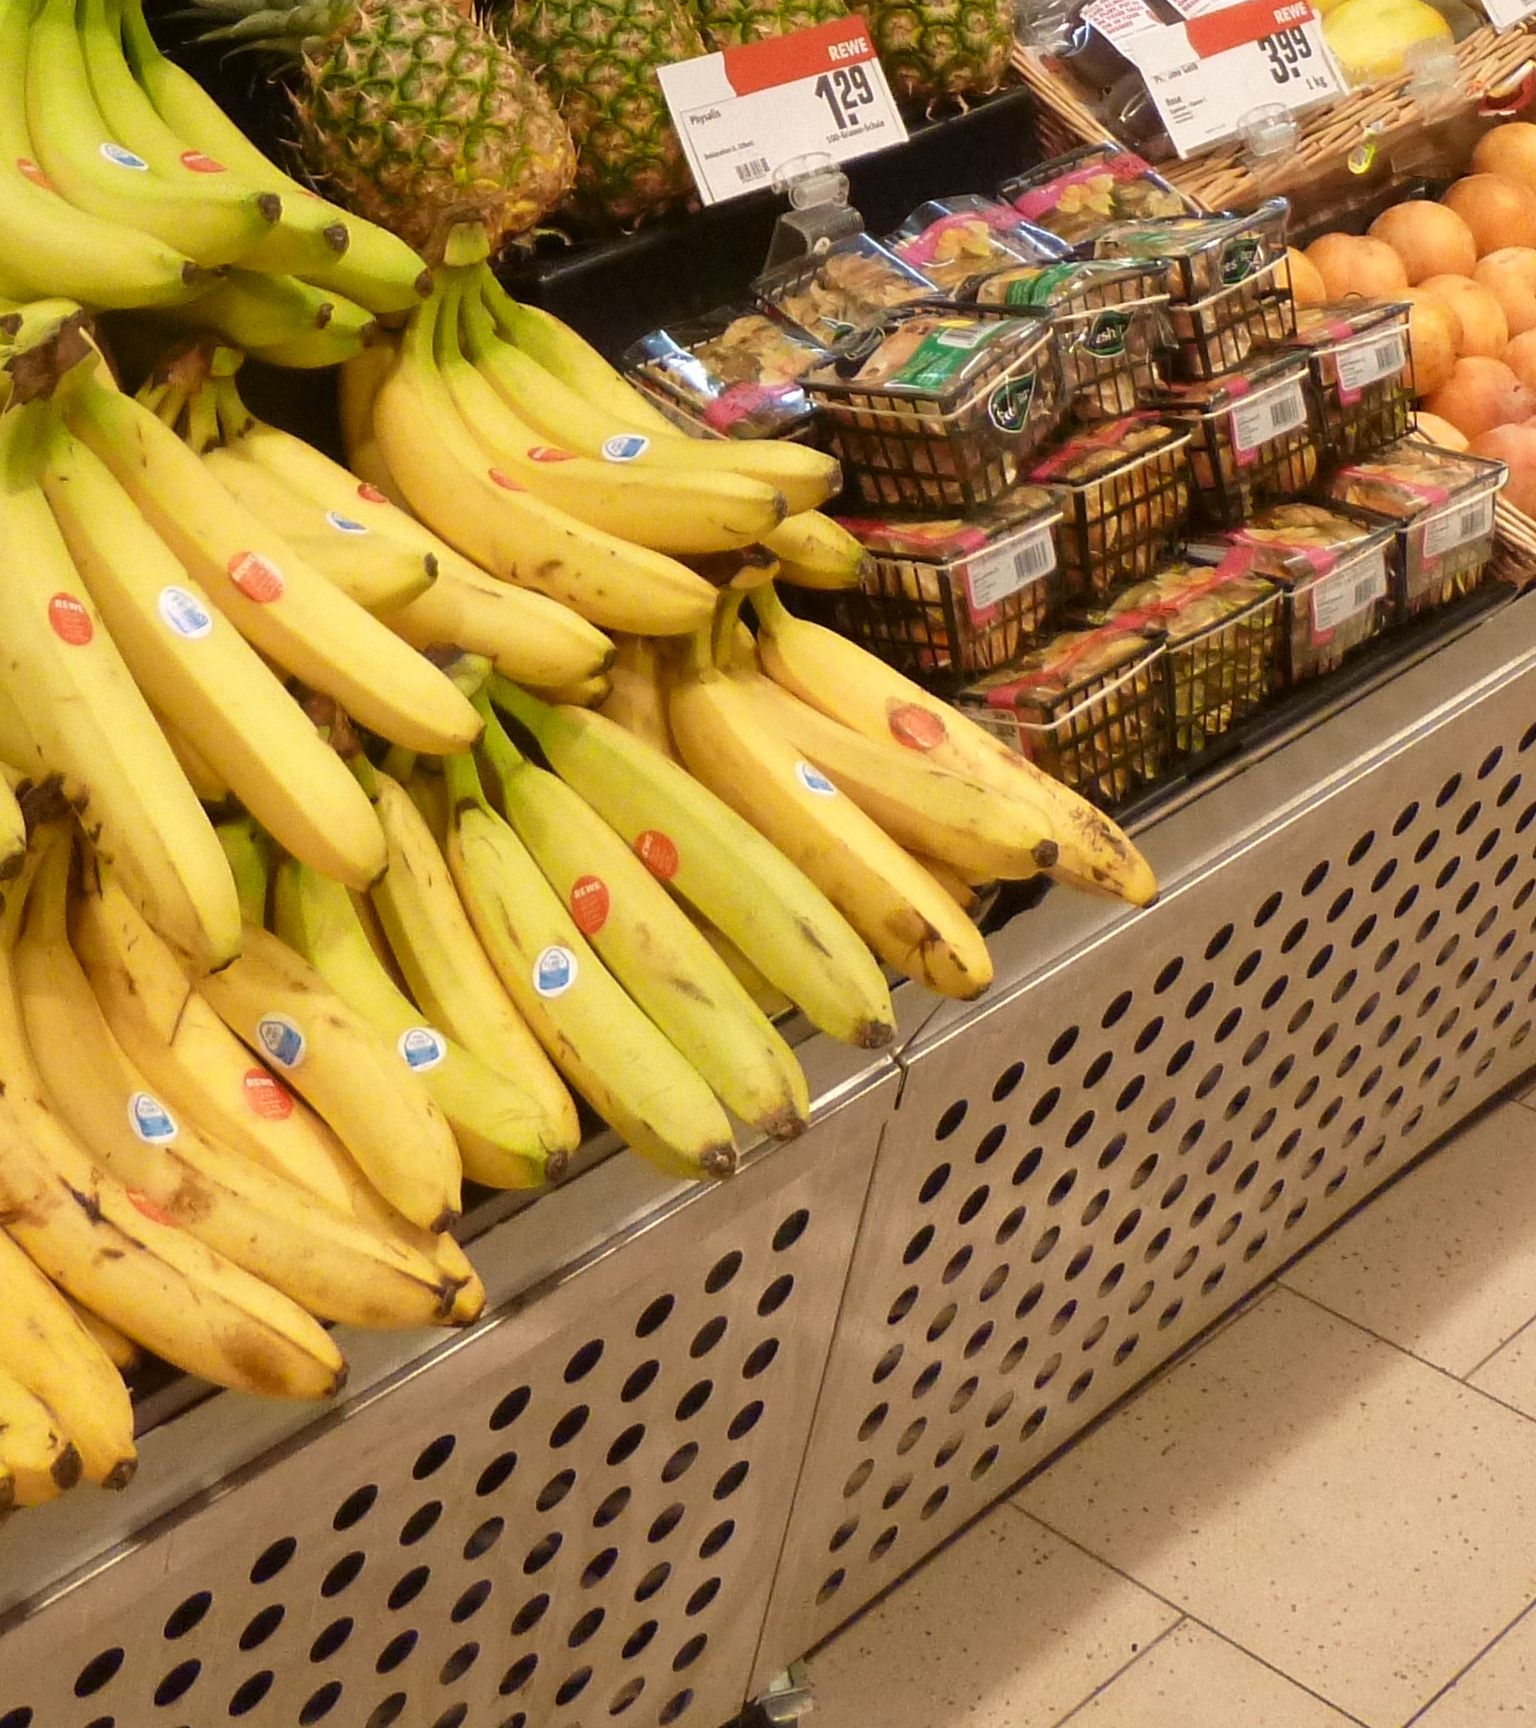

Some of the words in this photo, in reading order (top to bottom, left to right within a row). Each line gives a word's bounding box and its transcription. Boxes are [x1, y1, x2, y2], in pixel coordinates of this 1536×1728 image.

[1273, 2, 1308, 24] REWE
[828, 38, 869, 62] REWE
[1313, 75, 1328, 89] kg
[688, 108, 722, 126] Physalis
[54, 598, 85, 614] REWE
[573, 880, 602, 900] REWE
